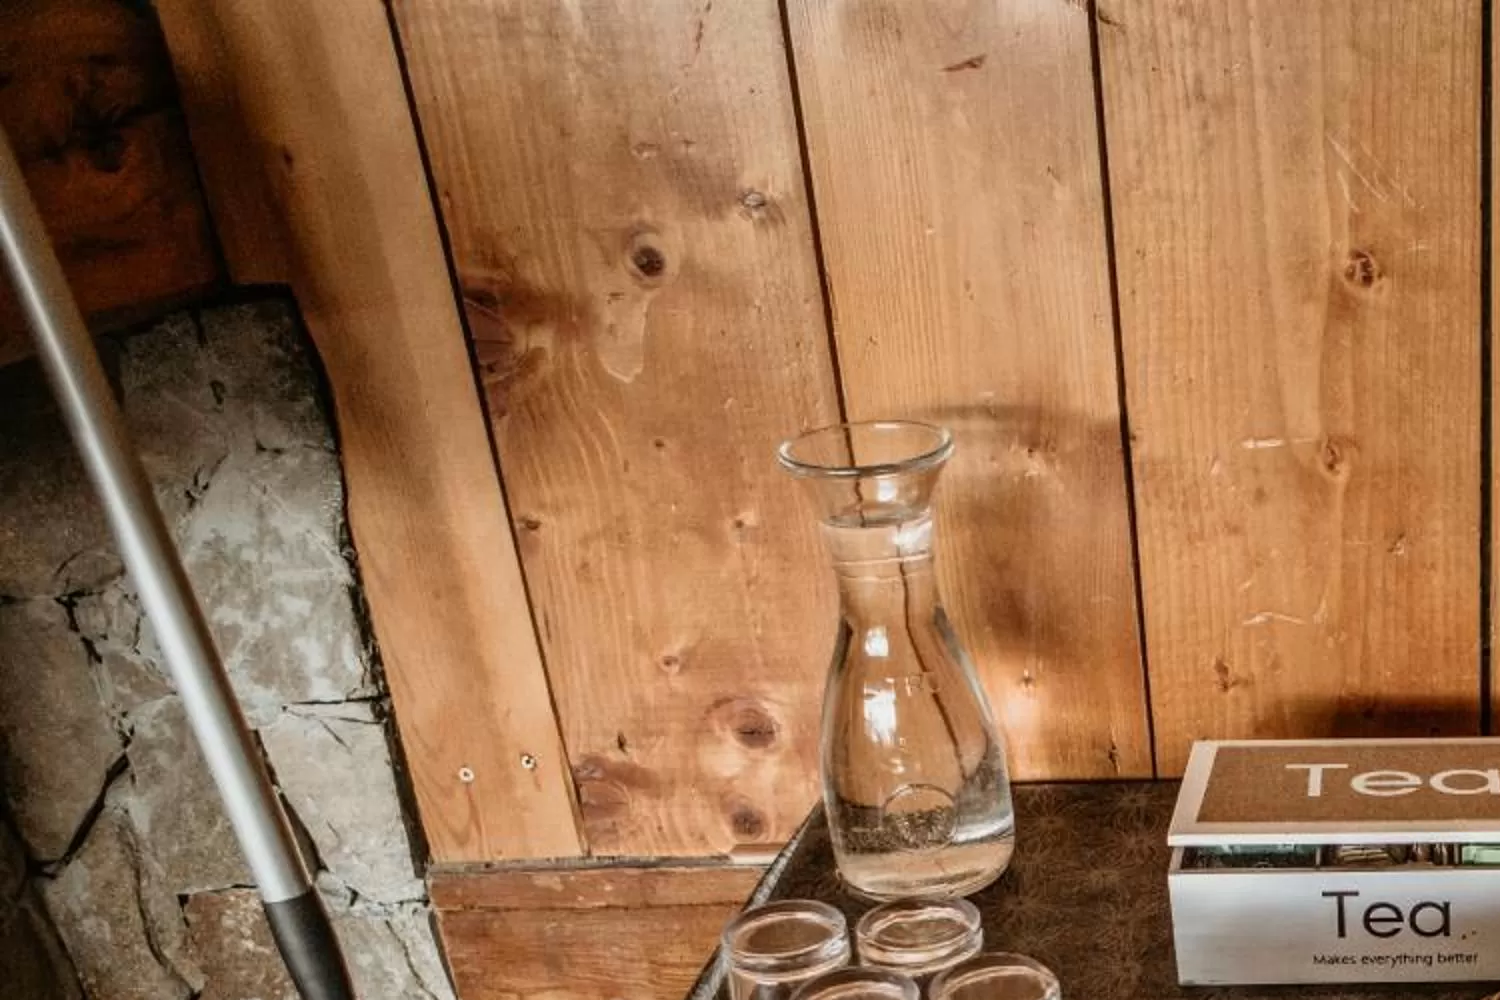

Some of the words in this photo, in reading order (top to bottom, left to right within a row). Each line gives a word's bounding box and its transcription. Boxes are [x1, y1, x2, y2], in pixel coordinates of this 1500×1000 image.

[1321, 890, 1452, 939] Tea
[1312, 953, 1357, 965] Makes
[1361, 952, 1433, 969] everything
[1437, 952, 1479, 964] better
